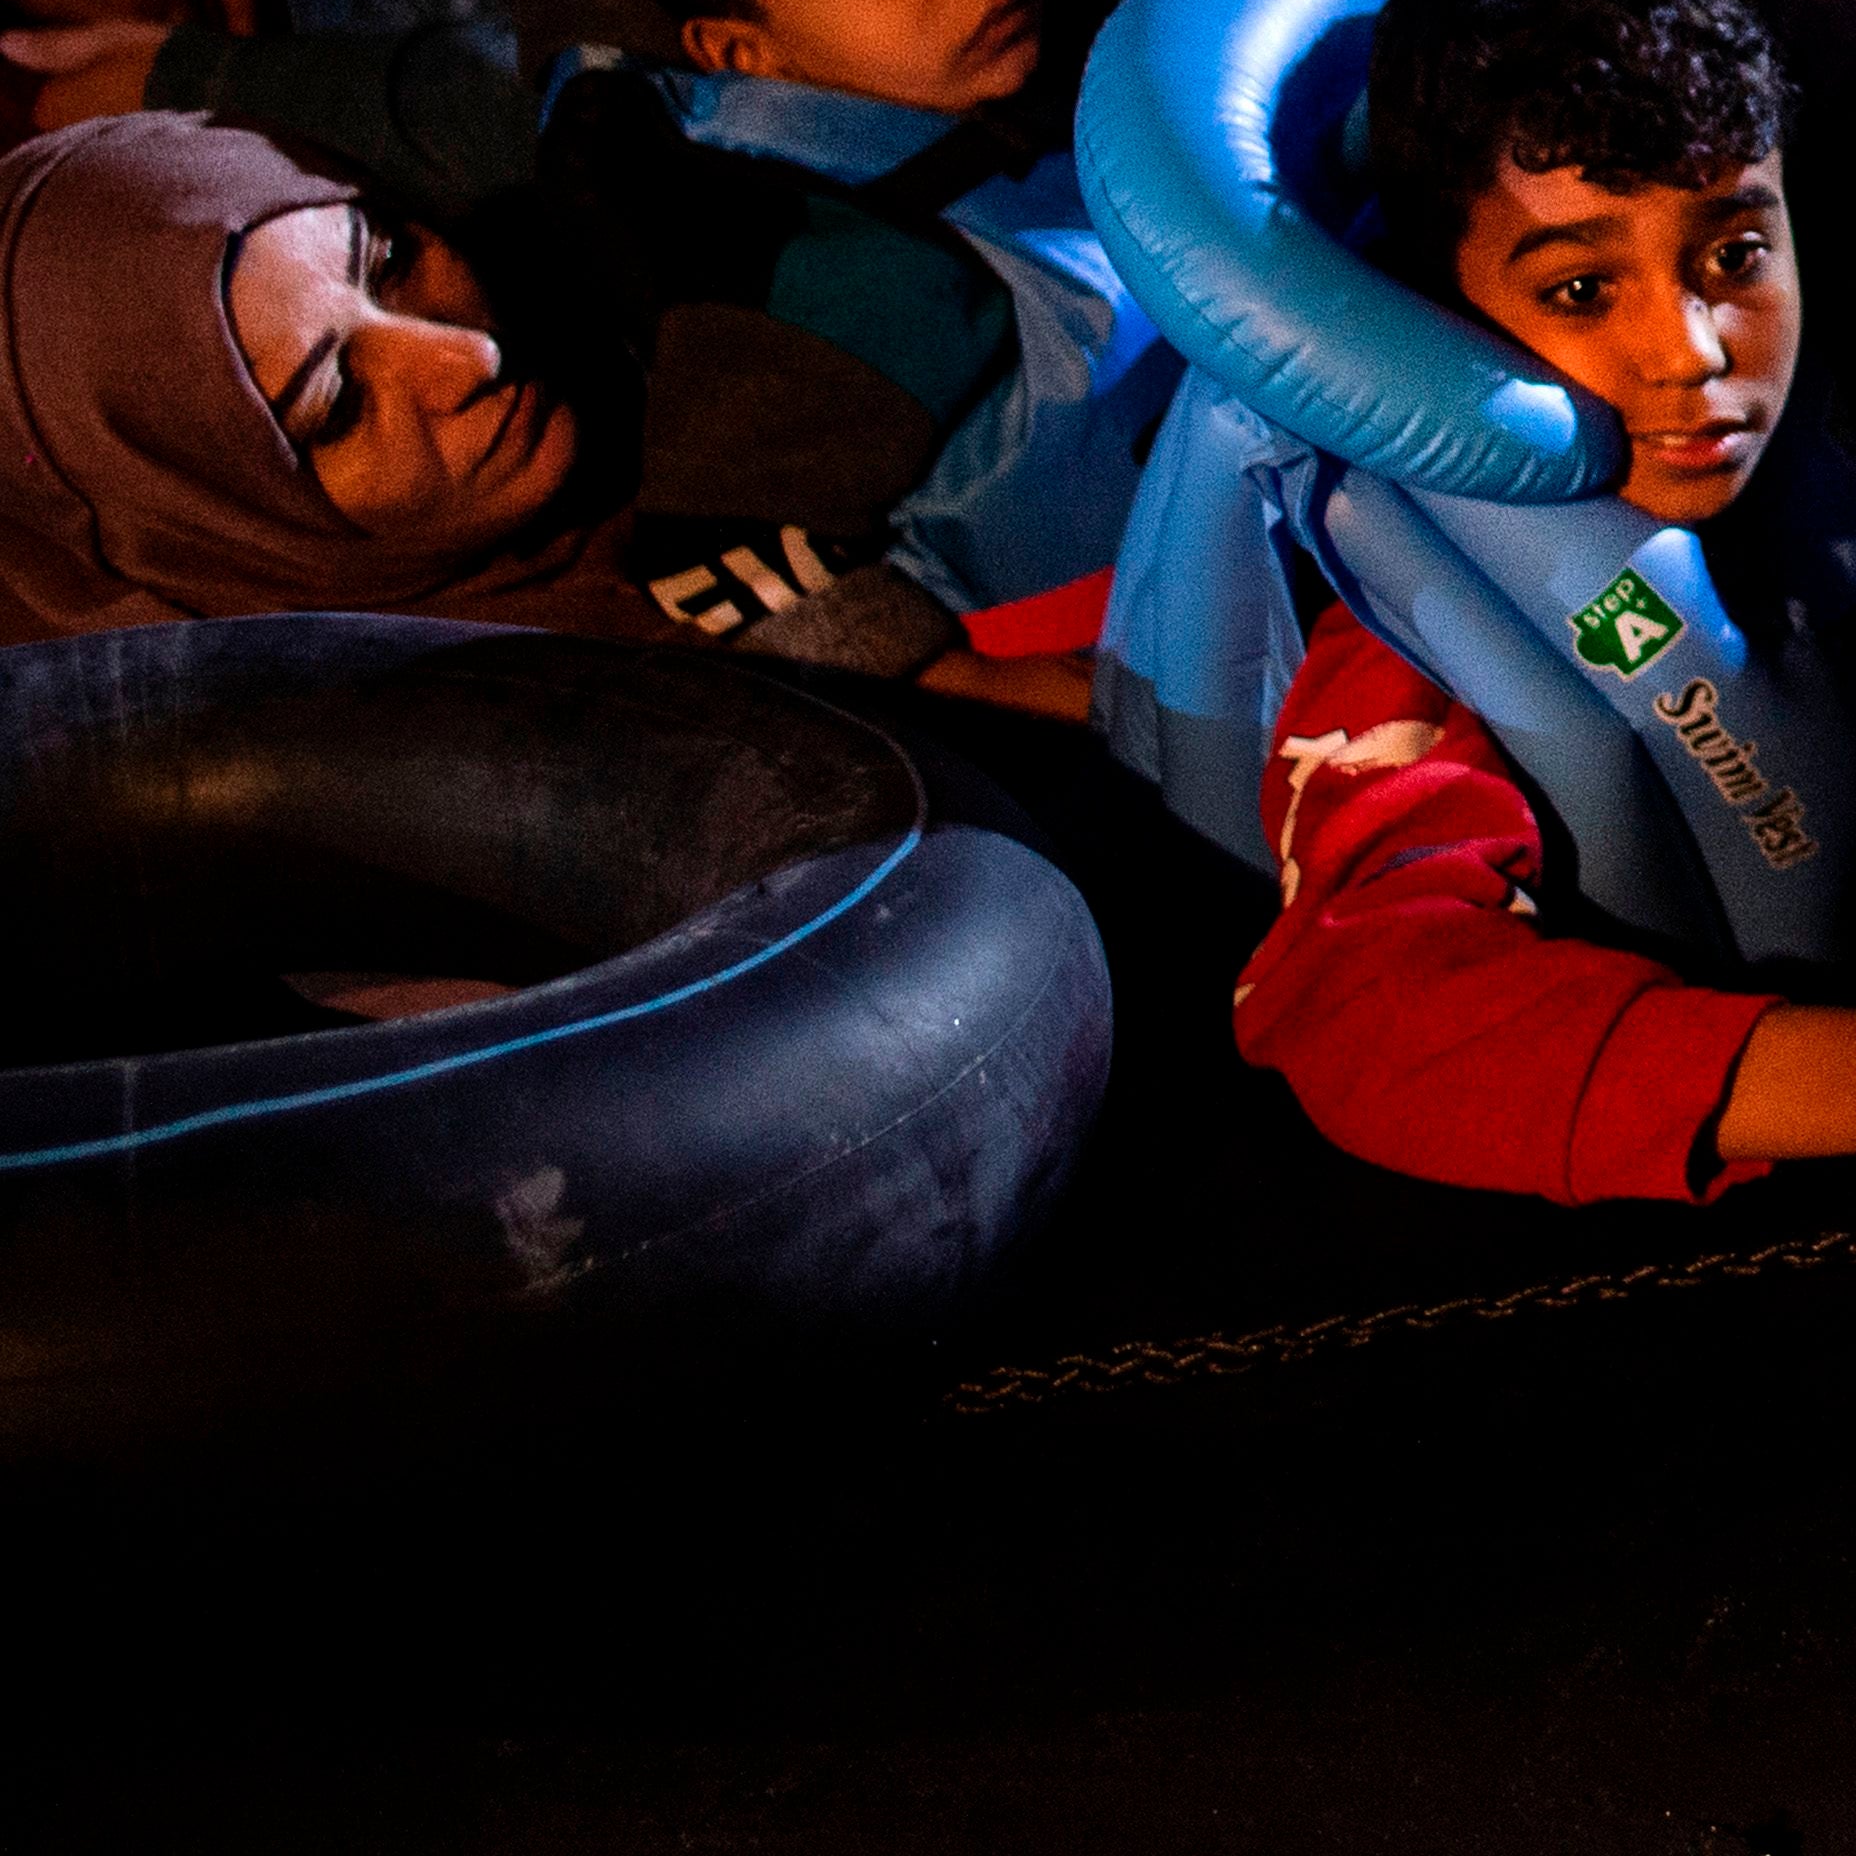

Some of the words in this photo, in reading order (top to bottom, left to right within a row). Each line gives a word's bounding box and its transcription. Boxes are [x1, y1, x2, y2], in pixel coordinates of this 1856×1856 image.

[1614, 609, 1670, 664] A
[1656, 680, 1765, 801] Swim
[1751, 790, 1819, 865] Vest
